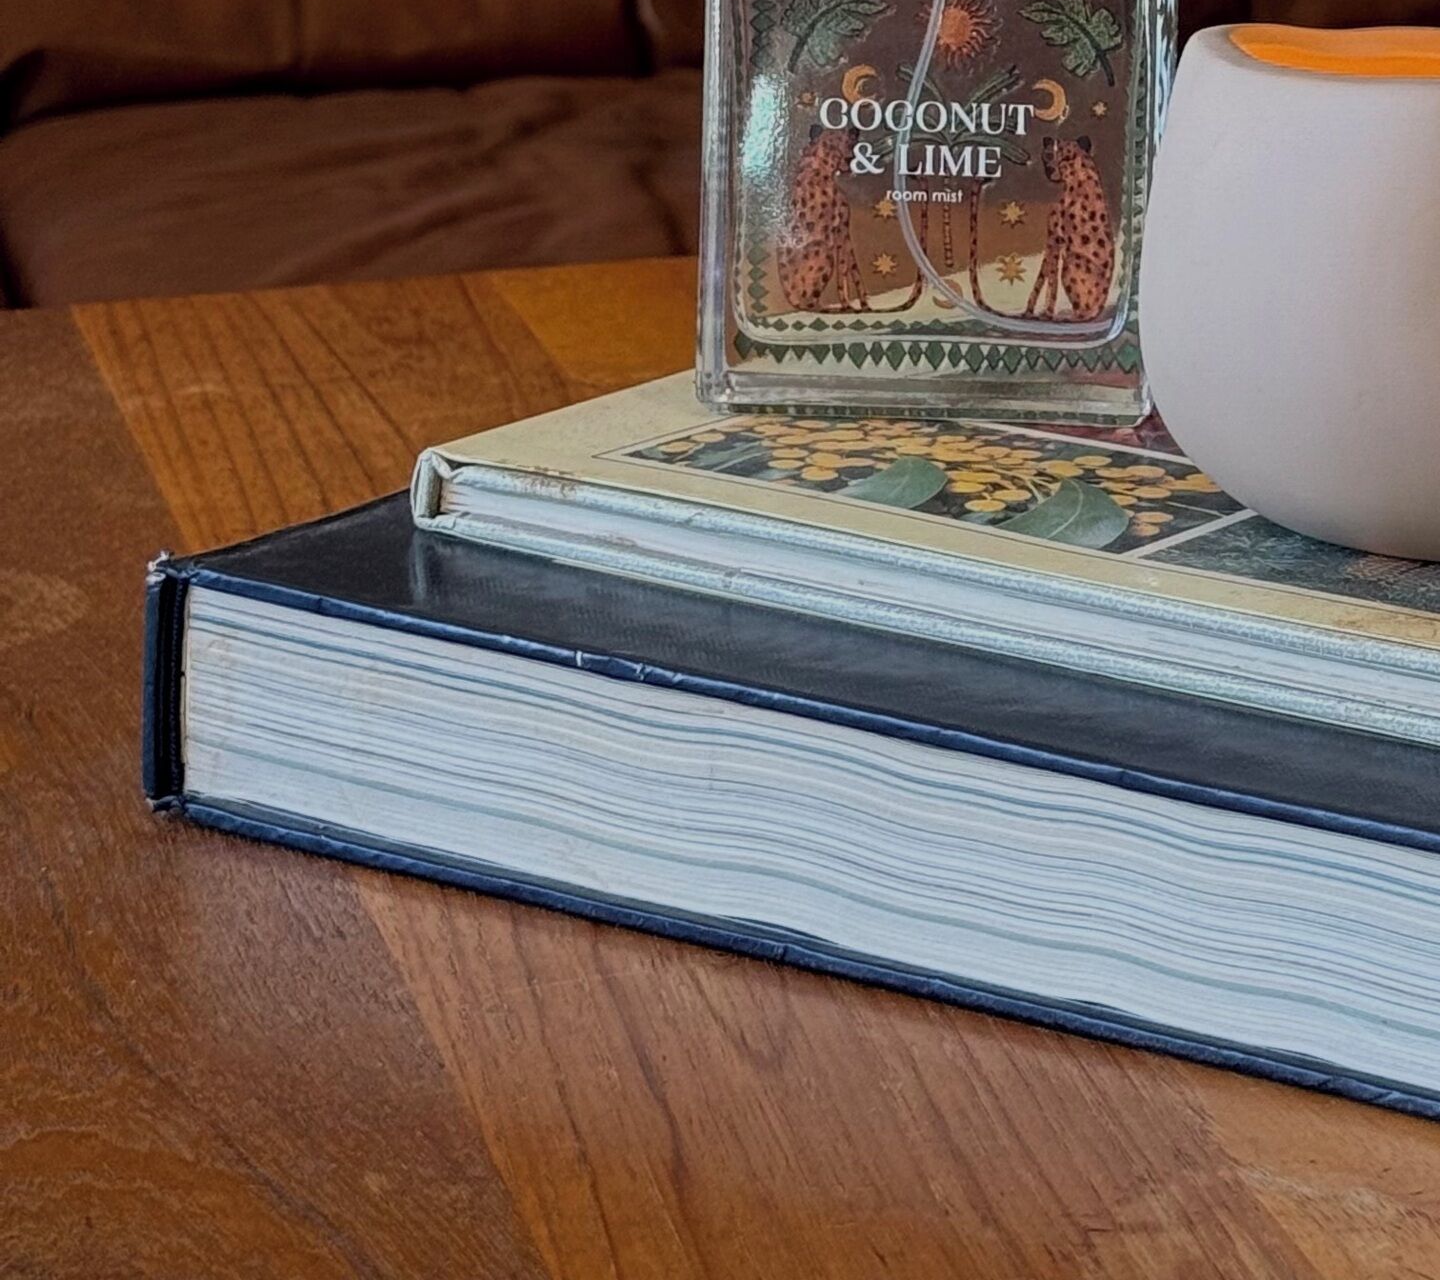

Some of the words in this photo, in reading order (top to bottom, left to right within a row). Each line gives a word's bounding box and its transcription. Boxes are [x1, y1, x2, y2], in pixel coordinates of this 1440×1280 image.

[819, 97, 1034, 135] COCONUT
[849, 142, 885, 175] &
[899, 143, 1002, 178] LIME
[886, 189, 927, 202] room
[932, 188, 964, 203] mist
